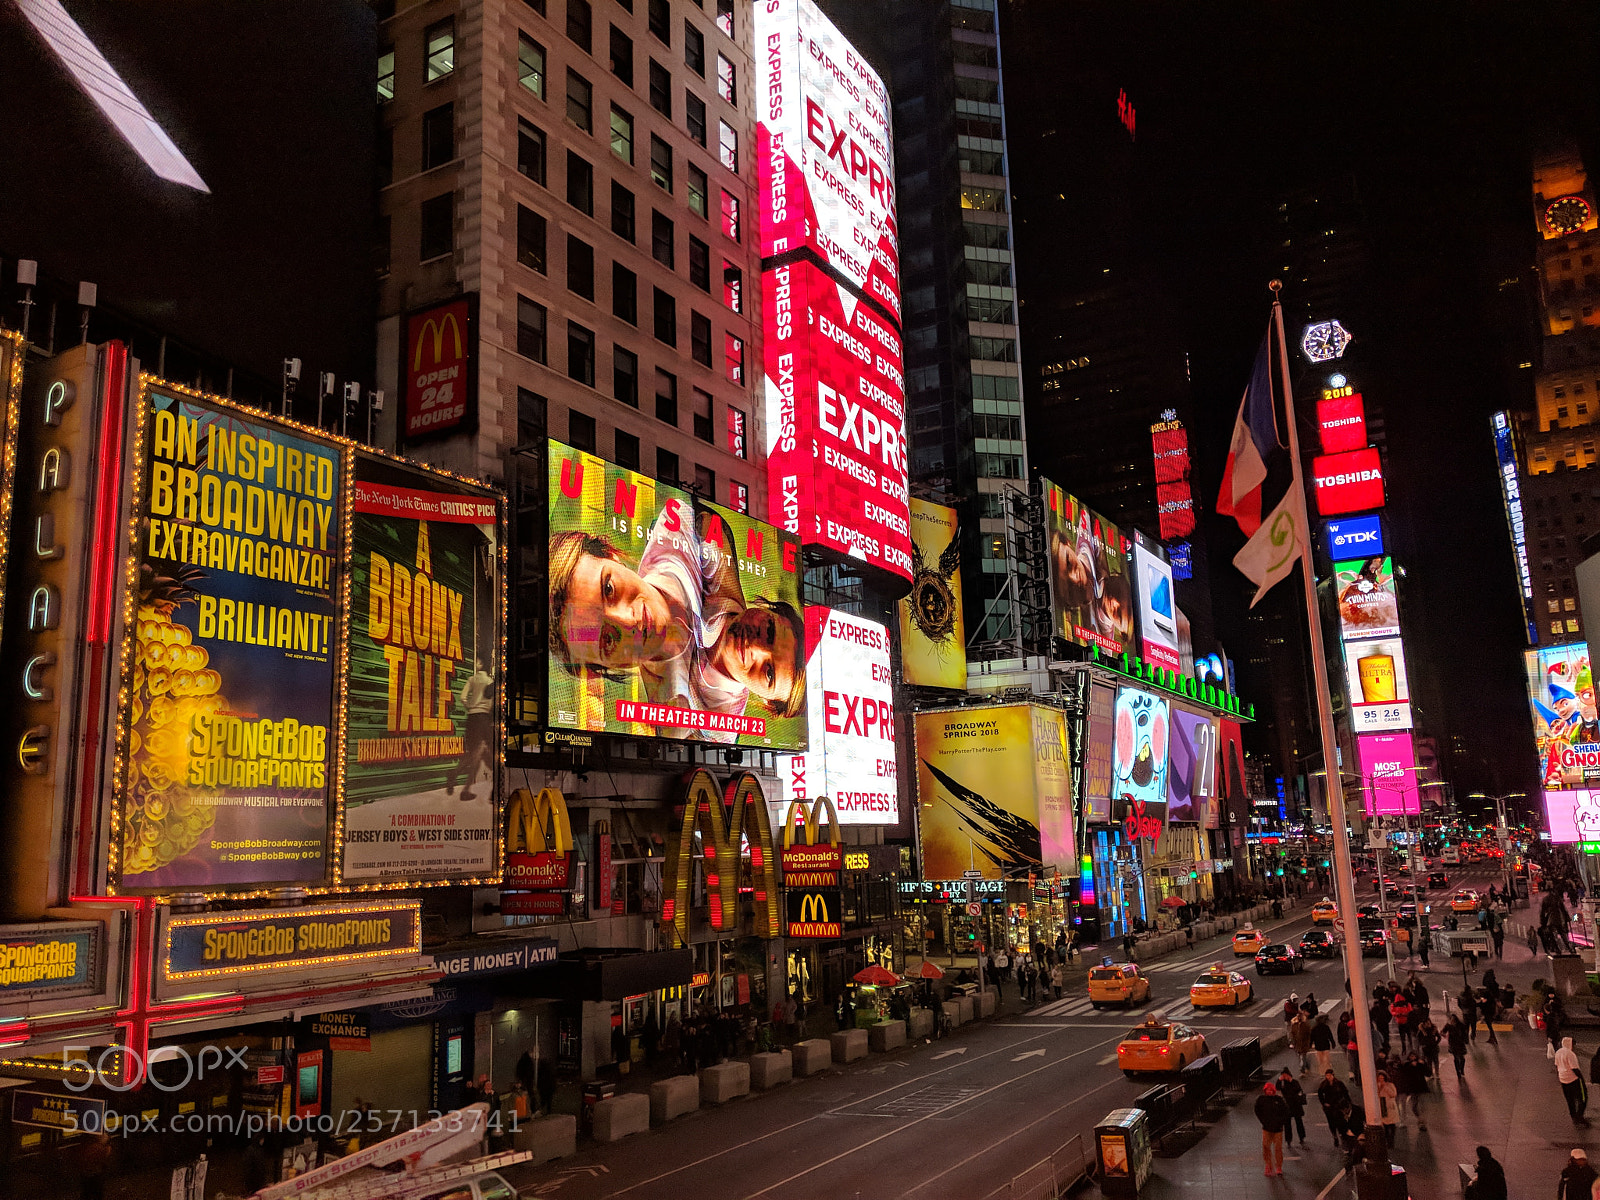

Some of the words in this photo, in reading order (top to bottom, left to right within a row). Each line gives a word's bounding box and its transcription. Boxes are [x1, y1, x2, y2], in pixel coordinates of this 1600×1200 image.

[767, 33, 783, 121] EXPRESS
[809, 38, 860, 103] EXPRESS
[848, 110, 891, 169] EXPRESS
[769, 131, 787, 224] EXPRESS
[813, 159, 865, 217] EXPRESS
[815, 227, 868, 283] EXPRESS
[853, 226, 897, 279] EXPRESS
[819, 314, 872, 365] EXPRESS
[856, 310, 900, 358] EXPRESS
[416, 365, 459, 388] OPEN
[420, 381, 454, 411] 24
[778, 352, 797, 453] EXPRESS
[859, 376, 903, 421] EXPRESS
[1324, 386, 1353, 400] 2018
[410, 403, 464, 429] HOURS
[1322, 416, 1362, 428] TOSHIBA
[207, 423, 333, 501] INSPIRED
[824, 445, 877, 488] EXPRESS
[1316, 468, 1382, 488] TOSHIBA
[1503, 463, 1520, 500] 2018
[151, 460, 333, 551] BROADWAY
[355, 488, 370, 503] The
[372, 490, 391, 505] New
[392, 494, 413, 511] York
[414, 496, 440, 512] Times
[477, 504, 496, 517] PICK
[560, 458, 798, 573] UNSANE
[864, 500, 908, 538] EXPRESS
[1510, 501, 1526, 545] HOUR
[415, 519, 432, 576] A
[612, 516, 627, 533] IS
[637, 525, 664, 546] SHE
[672, 537, 689, 553] OR
[738, 559, 767, 578] SHE?
[827, 519, 880, 558] EXPRESS
[1344, 530, 1378, 544] TDK
[17, 378, 72, 776] PALACE
[368, 550, 464, 662] BRONX
[829, 618, 882, 649] EXPRESS
[1361, 669, 1392, 678] ULTRA
[384, 644, 456, 735] TALE
[620, 703, 635, 719] IN
[641, 706, 705, 727] THEATERS
[709, 715, 749, 732] MARCH
[751, 719, 764, 733] 23
[944, 720, 997, 731] BROADWAY
[1035, 716, 1062, 741] HARRY
[1363, 710, 1377, 719] 95
[1384, 708, 1400, 718] 2.6
[190, 713, 327, 762] SPONGEBOB
[411, 738, 428, 759] NEW
[428, 738, 439, 757] HIT
[440, 736, 464, 756] MUSICAL
[943, 730, 977, 739] SPRING
[980, 728, 999, 737] 2018
[938, 746, 1007, 757] HarryPotterThePlay.com
[1034, 738, 1066, 763] POTTER
[188, 757, 325, 790] SQUAREPANTS
[1373, 770, 1404, 778] SATISFIED
[1374, 761, 1401, 771] MOST
[190, 796, 203, 807] THE
[204, 796, 243, 807] BROADWAY
[244, 796, 280, 808] MUSICAL
[280, 798, 293, 807] FOR
[293, 798, 324, 807] EVERYONE
[837, 791, 890, 813] EXPRESS
[397, 813, 447, 827] COMBINATION
[448, 814, 456, 826] OF
[210, 839, 321, 850] SpongeBobBroadway.com
[345, 830, 381, 844] JERSEY
[383, 829, 408, 843] BOYS
[409, 829, 416, 842] &
[418, 829, 443, 842] WEST
[444, 829, 462, 841] SIDE
[204, 925, 295, 960] SPONGEBOB
[298, 918, 391, 951] SQUAREPANTS
[474, 952, 523, 971] MONEY
[530, 946, 557, 963] ATM
[311, 1023, 367, 1037] EXCHANGE
[319, 1013, 356, 1025] MONEY
[331, 1150, 380, 1176] SELECT
